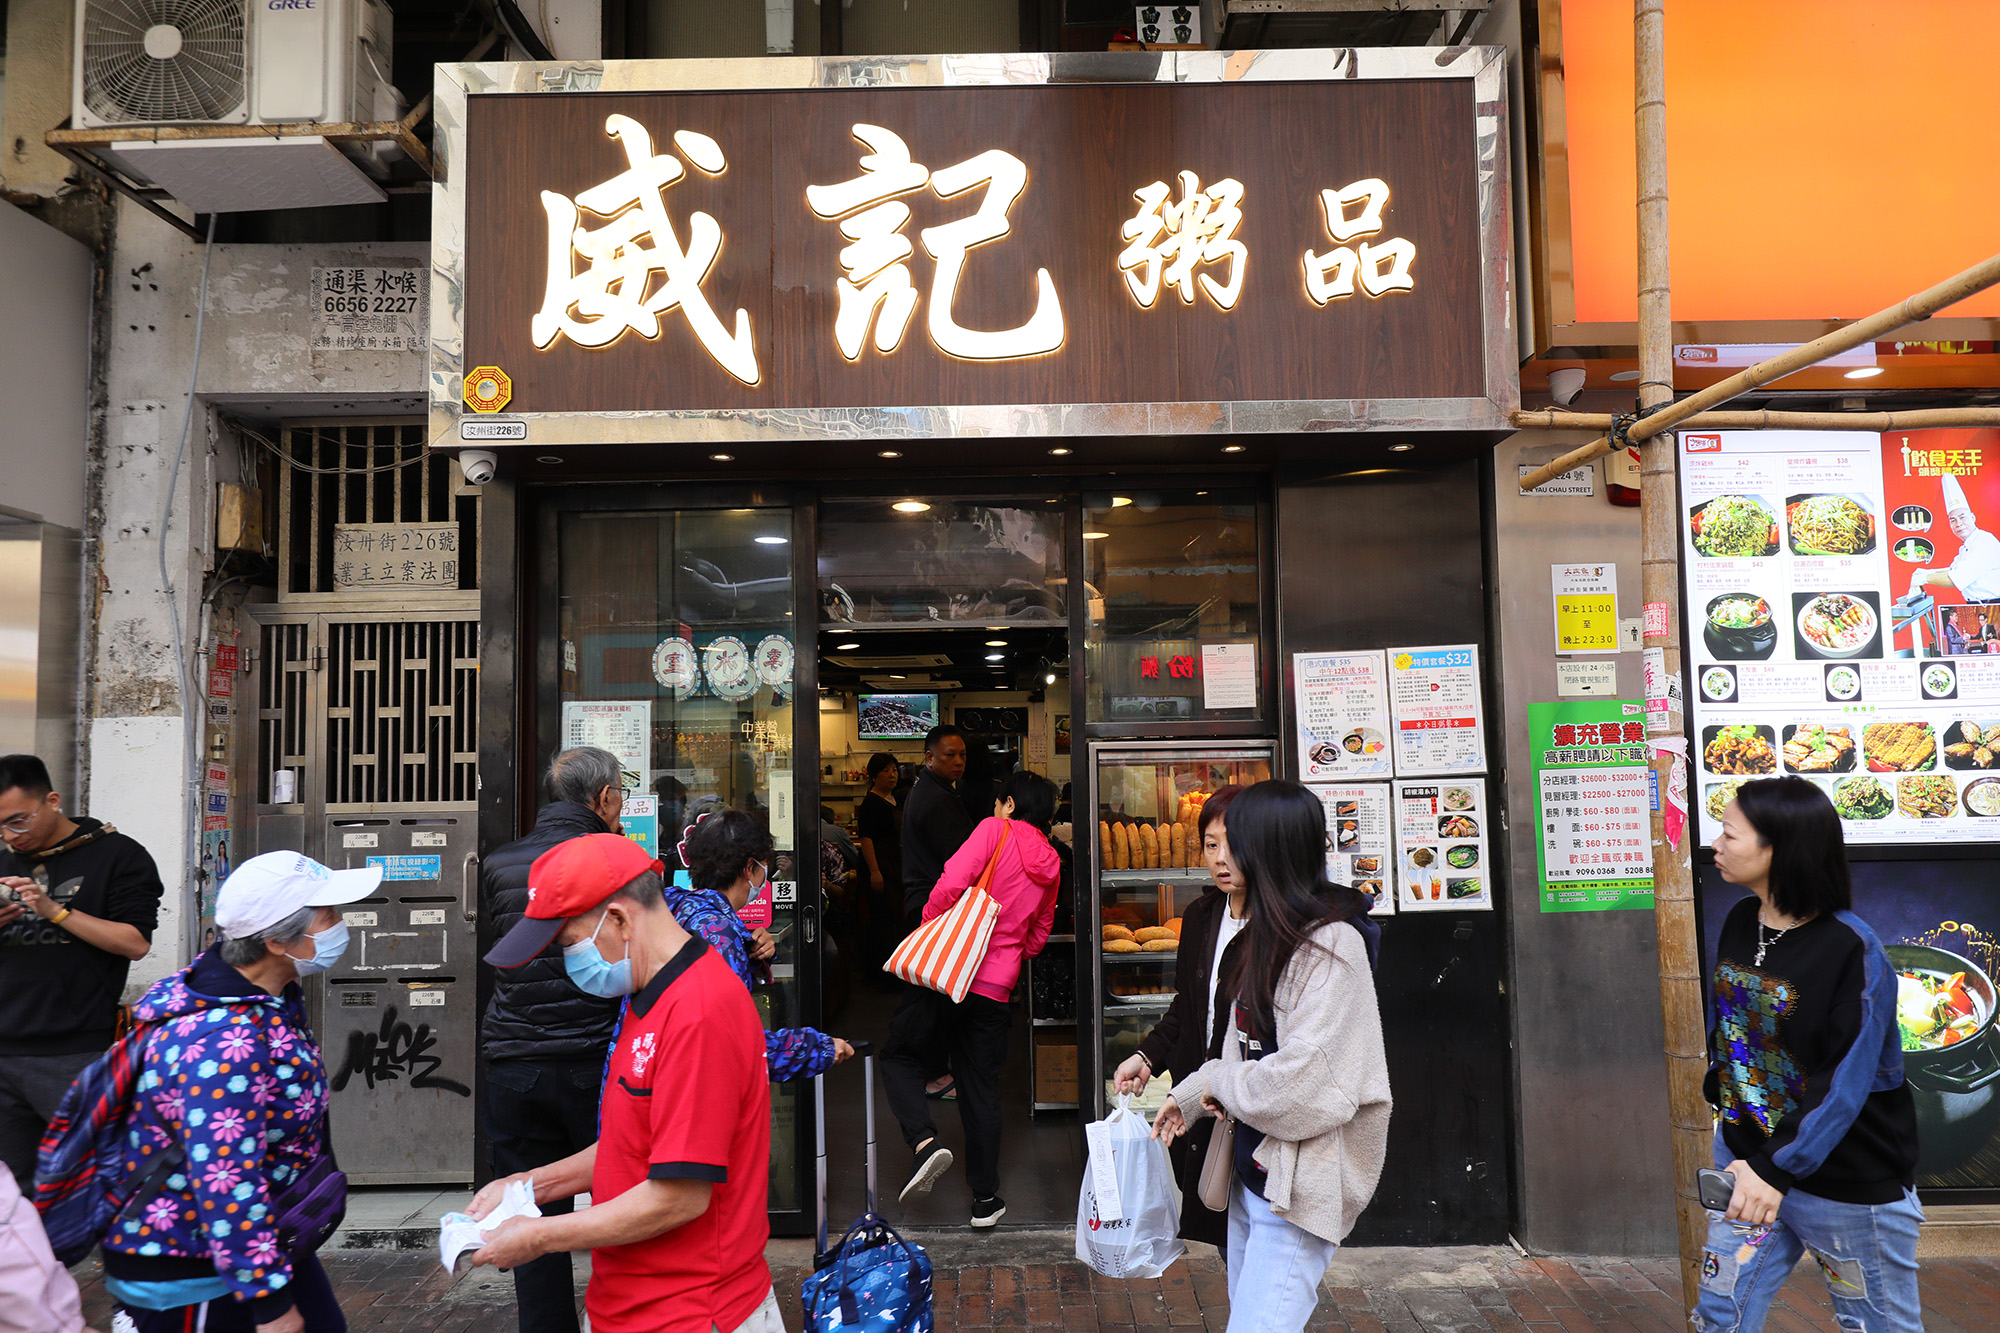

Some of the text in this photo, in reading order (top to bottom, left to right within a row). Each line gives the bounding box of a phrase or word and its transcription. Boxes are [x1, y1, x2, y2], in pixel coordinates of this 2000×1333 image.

[268, 0, 316, 10] GREE
[325, 296, 418, 313] 6656 2227
[466, 425, 522, 436] 汝州街226號
[1911, 449, 1983, 467] 飲食天王
[339, 560, 456, 582] 業主立案法團
[1583, 620, 1591, 628] 至
[1307, 659, 1336, 668] 港式套餐
[1413, 651, 1471, 667] 特價套餐 $32
[1319, 667, 1357, 676] 中午12點後
[1553, 721, 1646, 747] 擴充營業
[1543, 773, 1638, 786] 分店經理: $26000 $32000
[1582, 789, 1611, 799] $22500
[1617, 788, 1646, 798] $27000
[1583, 807, 1598, 815] $60
[1604, 806, 1620, 815] $80
[1584, 823, 1600, 832] $60
[1605, 822, 1621, 831] $75
[1585, 839, 1601, 848] $60
[1606, 838, 1622, 847] $75
[1569, 852, 1644, 864] 歡迎全職或兼職
[1576, 868, 1595, 876] 9096
[1596, 867, 1616, 875] 0368
[1624, 867, 1644, 875] 5208
[777, 882, 792, 897] 移
